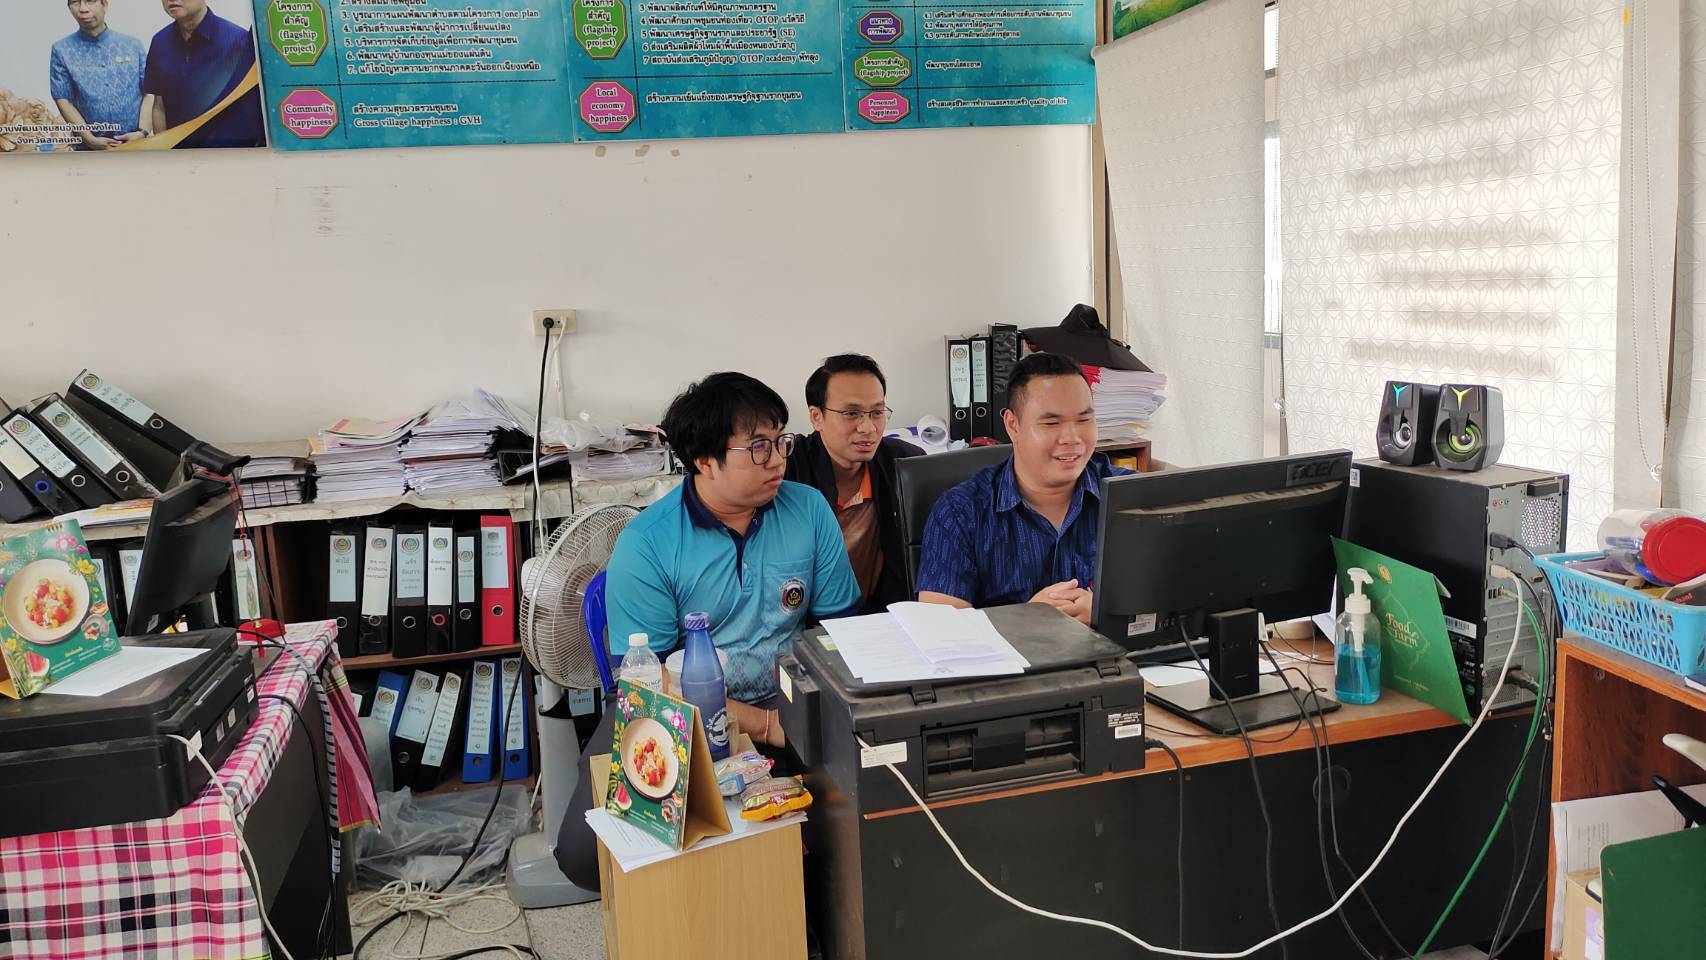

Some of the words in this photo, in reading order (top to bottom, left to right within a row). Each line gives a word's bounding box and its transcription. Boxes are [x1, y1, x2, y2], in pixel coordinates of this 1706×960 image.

[276, 0, 312, 11] โครงการ
[504, 10, 519, 18] one
[522, 9, 539, 19] plan
[588, 10, 610, 21] สำคัญ
[284, 15, 309, 26] สำคัญ
[756, 15, 779, 24] OTOP
[343, 24, 351, 32] 4.
[583, 25, 618, 35] (flagship
[279, 30, 317, 41] (flagship
[641, 30, 647, 38] 5
[780, 29, 796, 37] (SE)
[345, 38, 354, 46] 5.
[587, 38, 617, 49] project)
[283, 45, 316, 55] project)
[346, 52, 355, 60] 6.
[766, 54, 797, 63] academy
[347, 65, 357, 74] 7.
[596, 88, 617, 96] Local
[285, 104, 335, 115] Community
[591, 102, 625, 111] economy
[290, 117, 333, 128] happiness
[355, 119, 379, 127] Gross
[381, 118, 409, 128] village
[411, 117, 451, 128] happiness
[460, 117, 481, 126] GVH
[590, 114, 628, 124] happiness
[0, 122, 121, 134] านพัฒนาชุมชนอำเภอพังโคน
[17, 136, 82, 144] จังหวัดสกลนคร
[1385, 612, 1411, 634] Food
